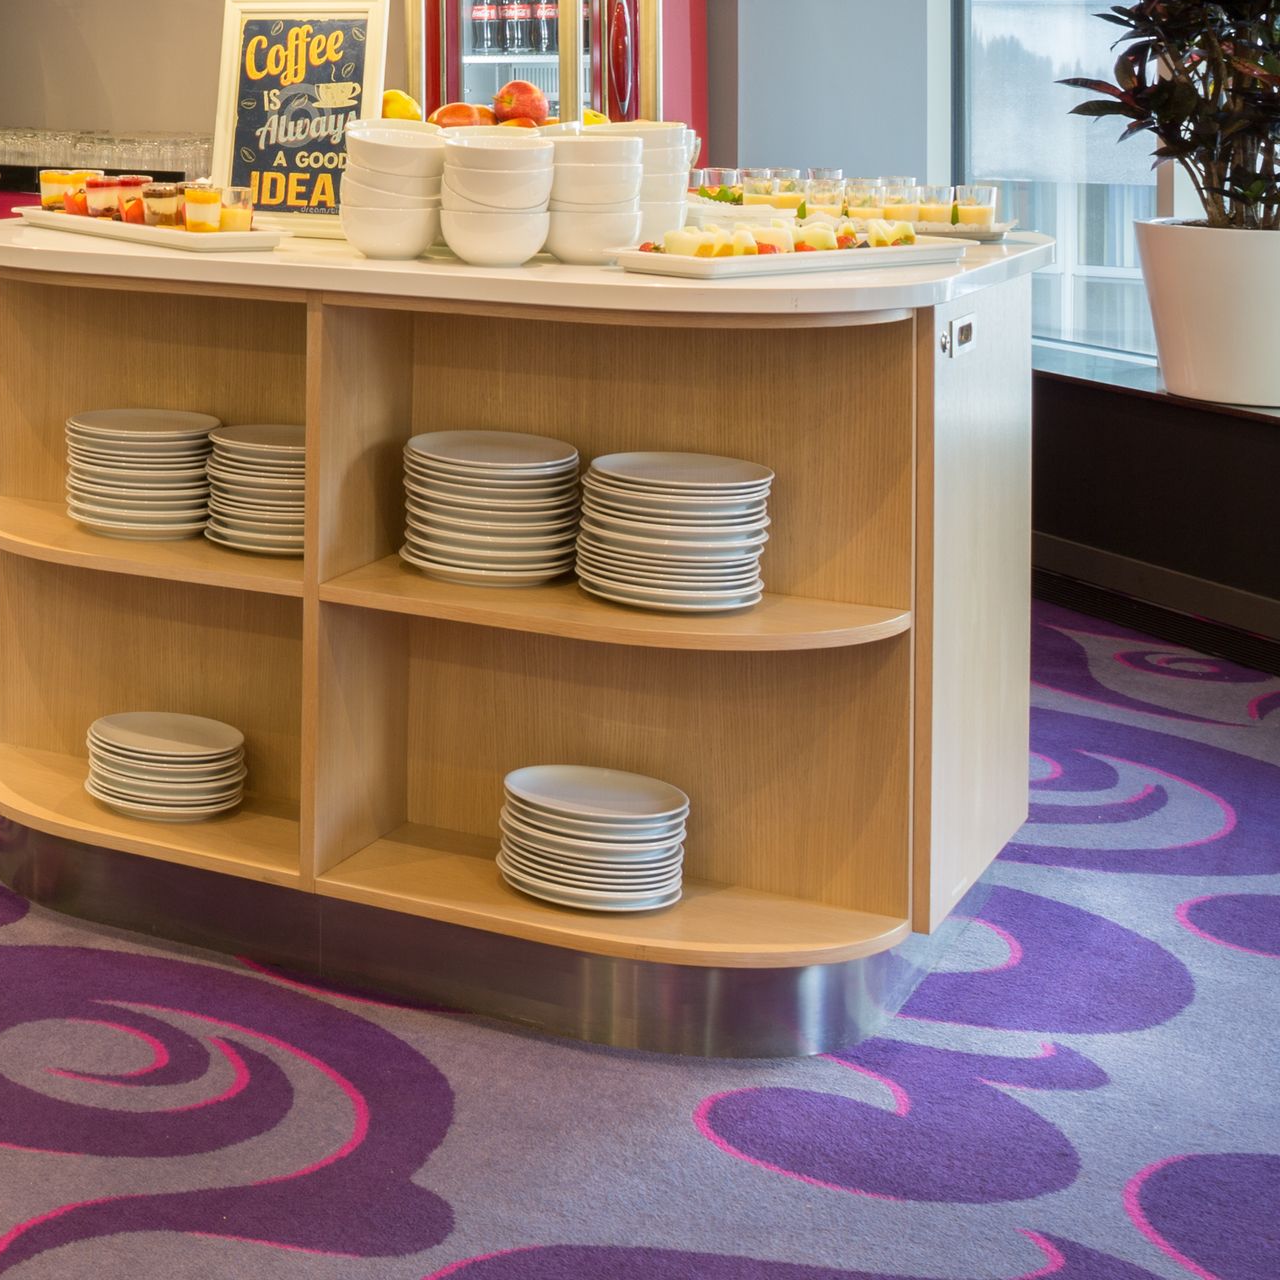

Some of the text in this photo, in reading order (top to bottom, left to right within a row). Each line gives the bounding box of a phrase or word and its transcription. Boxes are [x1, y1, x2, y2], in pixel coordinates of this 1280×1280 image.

[245, 24, 344, 86] Coffee
[263, 89, 282, 111] IS
[272, 151, 348, 169] A GOOD
[250, 171, 336, 207] IDEA
